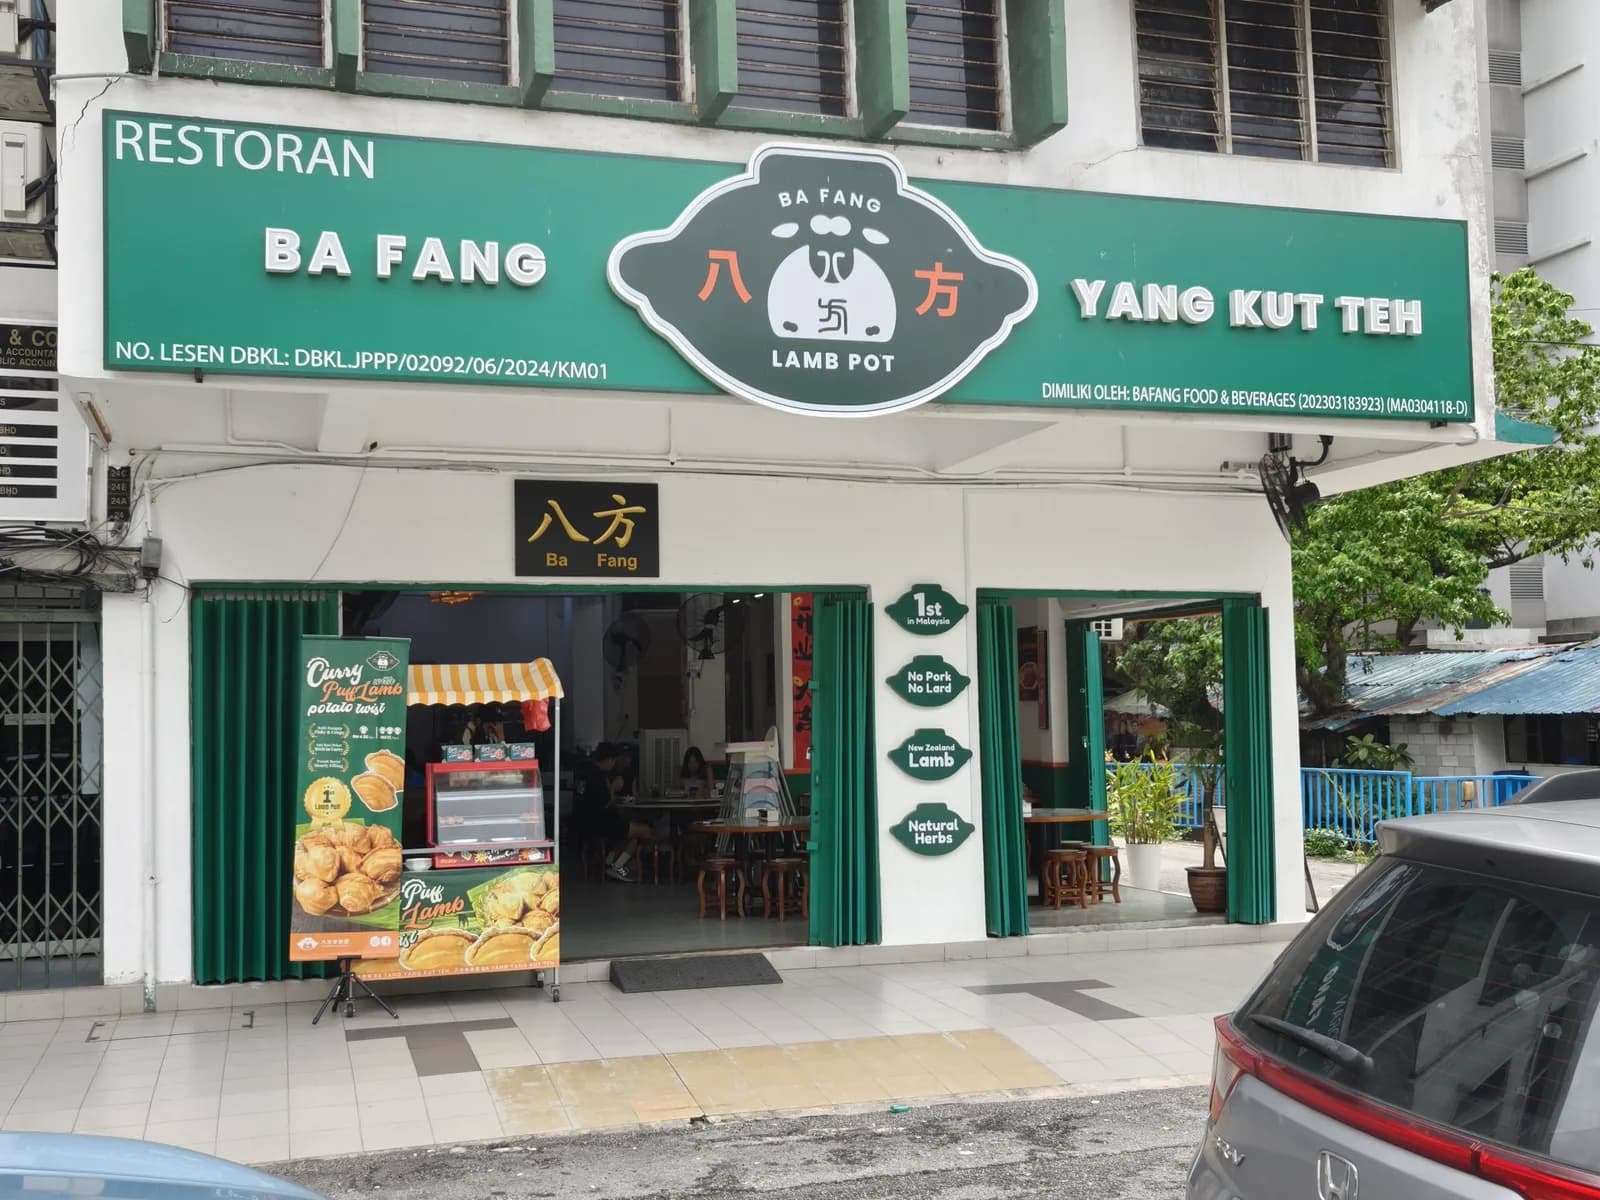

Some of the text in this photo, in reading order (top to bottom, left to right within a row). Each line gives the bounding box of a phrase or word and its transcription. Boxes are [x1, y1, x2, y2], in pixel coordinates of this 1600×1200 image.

[115, 119, 374, 179] RESTORAN
[778, 188, 881, 213] BA FANG
[264, 227, 547, 286] BA FANG
[698, 249, 964, 317] 八 方
[1070, 278, 1423, 337] YANG KUT TEH
[115, 341, 609, 380] NO. LESEN DBKL: DBKL.JPPP/02092/06/2024/KM01
[772, 350, 894, 373] LAMB POT
[1042, 383, 1468, 417] DIMILIKI OLEH: BAFANG FOOD & BEVERAGES (202303183923) (MA0304118-D)
[528, 494, 647, 549] 八方
[546, 553, 638, 571] Ba Fang
[913, 592, 942, 617] 1st
[907, 617, 951, 627] in Malaysia
[306, 656, 364, 688] Curry
[908, 671, 952, 682] No Pork
[320, 681, 403, 702] Puff Lamb
[908, 682, 952, 693] No Lard
[307, 701, 386, 716] potato twist
[908, 743, 955, 752] New Zealand
[908, 752, 955, 768] Lamb
[908, 818, 959, 833] Natural
[915, 831, 953, 845] Herbs
[401, 879, 445, 911] Puff
[402, 896, 465, 929] Lamb
